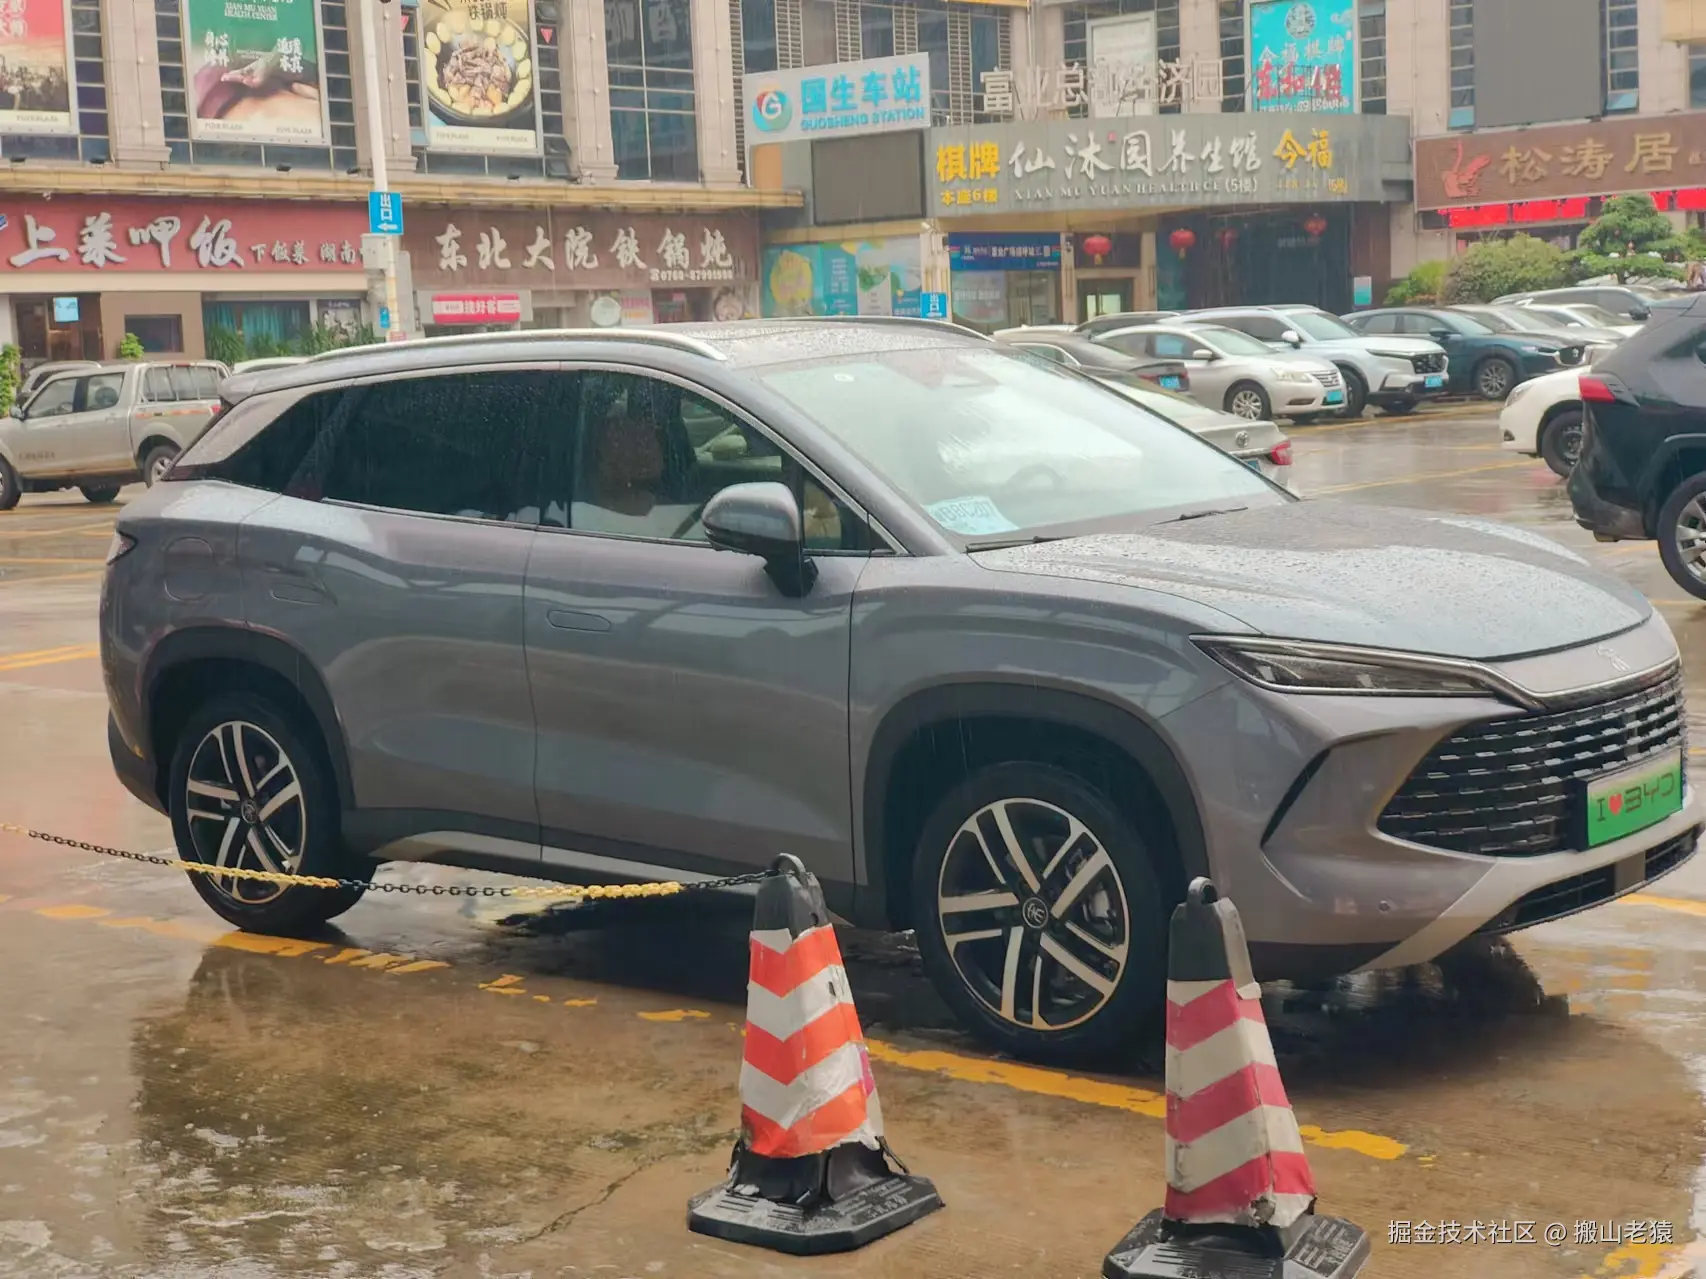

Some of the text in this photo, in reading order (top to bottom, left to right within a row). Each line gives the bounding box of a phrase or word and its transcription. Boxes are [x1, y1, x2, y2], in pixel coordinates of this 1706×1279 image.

[801, 64, 922, 114] 国生车站
[801, 106, 925, 131] GUOSHENG STATION
[936, 141, 1001, 182] 棋牌
[1500, 132, 1679, 184] 松涛居
[380, 193, 393, 221] 出口
[1014, 187, 1052, 201] XIAN
[1089, 183, 1132, 197] YUAN
[8, 211, 246, 268] 上菜呷饭
[320, 240, 363, 264] 湖南
[435, 223, 734, 271] 东北大院铁锅炖
